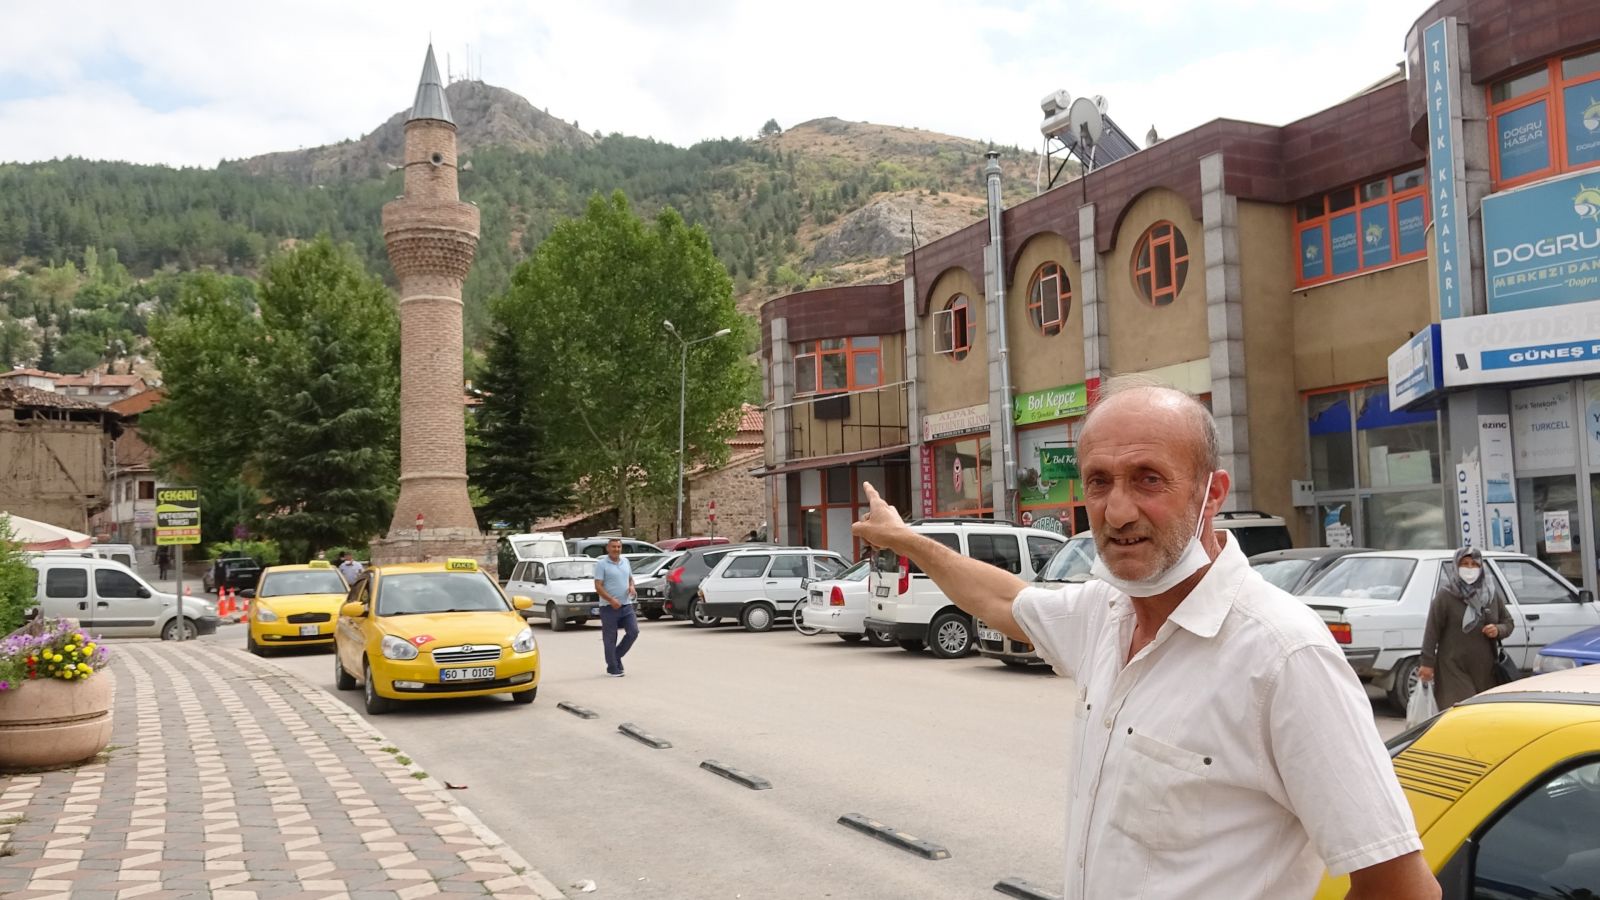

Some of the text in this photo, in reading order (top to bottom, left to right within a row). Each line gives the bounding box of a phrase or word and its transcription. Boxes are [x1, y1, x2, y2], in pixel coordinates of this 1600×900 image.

[1504, 130, 1543, 149] HASAR
[1431, 40, 1453, 308] TRAFİK KAZALARI
[1493, 227, 1600, 267] DOĞRU
[1509, 346, 1584, 363] GÜNEŞ
[1028, 394, 1044, 411] Bol
[1530, 401, 1557, 409] Telekom
[939, 408, 976, 420] ALPAK
[445, 668, 494, 679] 60 T 0105
